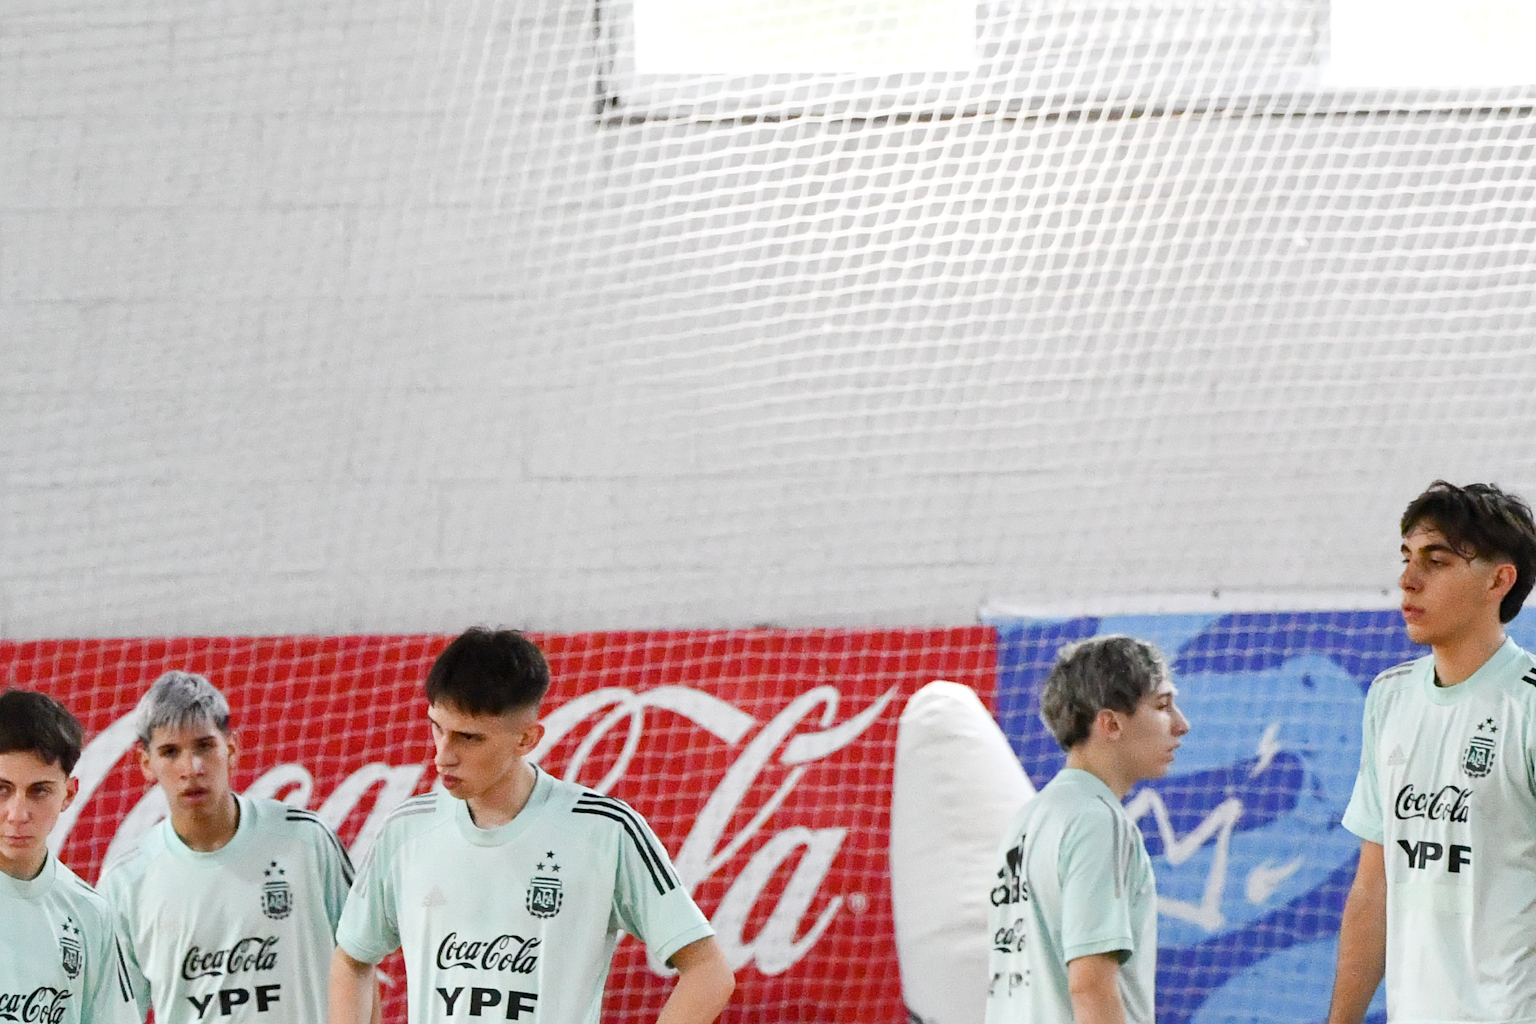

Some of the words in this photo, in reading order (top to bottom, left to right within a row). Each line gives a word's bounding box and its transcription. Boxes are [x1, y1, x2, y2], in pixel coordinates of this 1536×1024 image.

[1397, 839, 1473, 874] YPF
[181, 935, 280, 981] Coca-Cola
[436, 931, 543, 975] Coca-Cola
[187, 983, 282, 1020] YPF
[435, 986, 539, 1021] YPF
